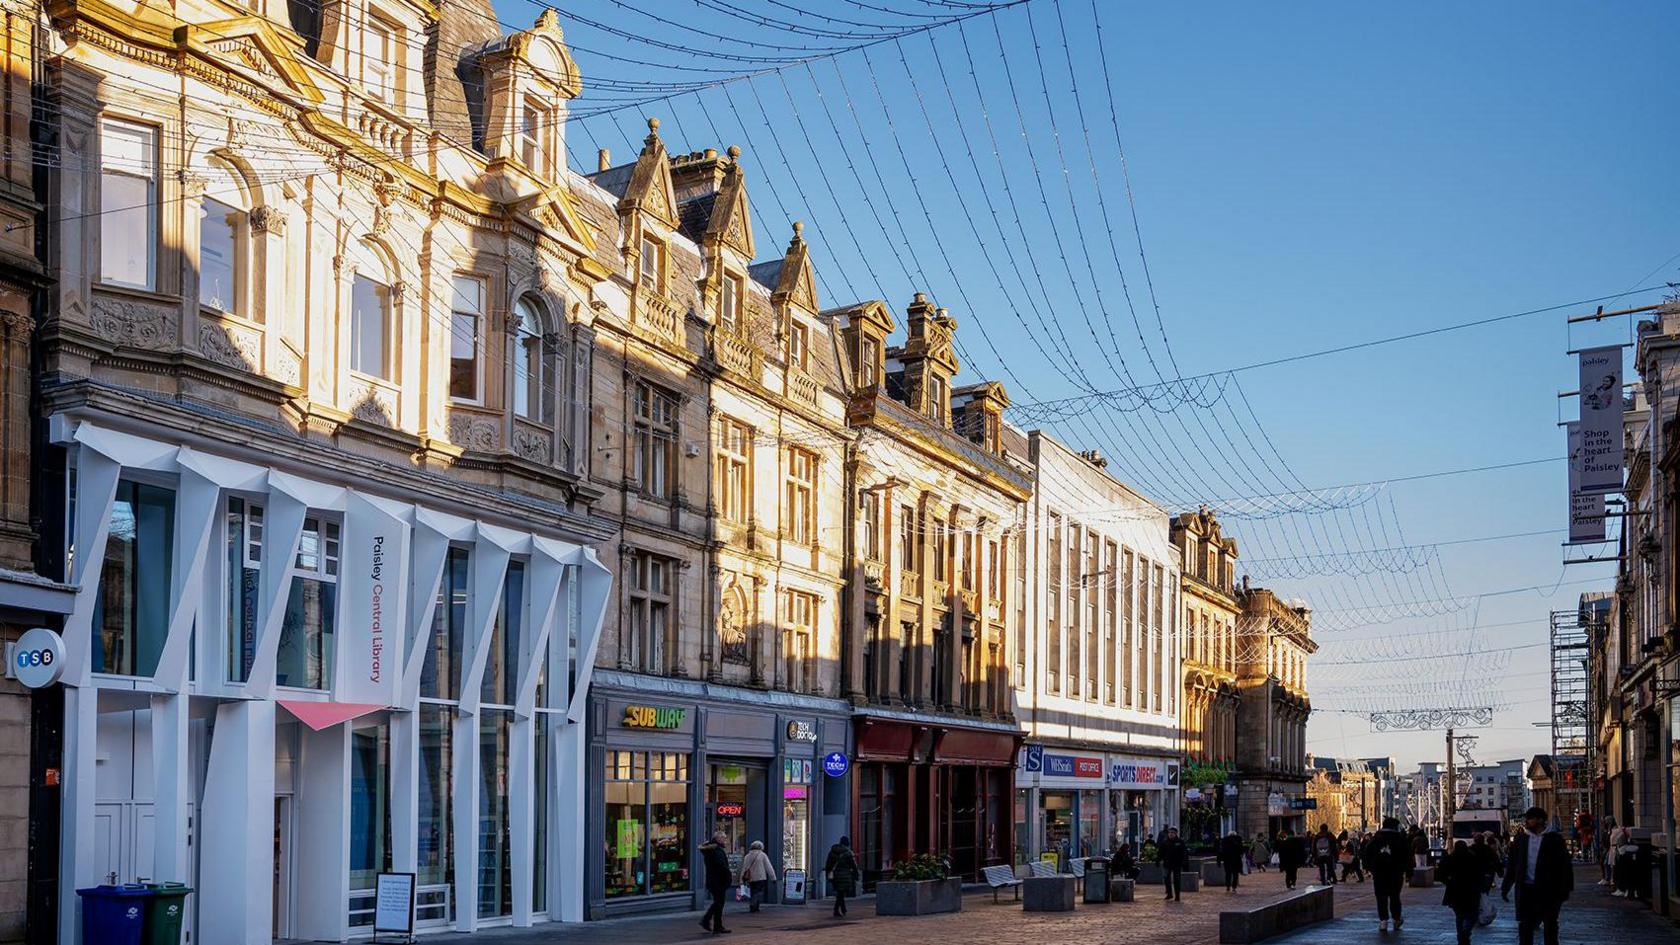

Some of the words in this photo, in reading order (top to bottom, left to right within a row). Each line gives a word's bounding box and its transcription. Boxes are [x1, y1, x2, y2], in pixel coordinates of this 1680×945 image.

[1583, 357, 1609, 367] paisley
[1584, 430, 1609, 439] Shop
[1584, 439, 1594, 447] in
[1596, 438, 1612, 446] the
[1584, 447, 1611, 456] heart
[1584, 464, 1619, 472] Paisley
[371, 536, 384, 581] Paisley
[372, 584, 383, 633] Central
[20, 652, 51, 665] TSB
[370, 637, 383, 683] Library
[624, 705, 688, 729] SUBWAY
[717, 805, 742, 814] OPEN
